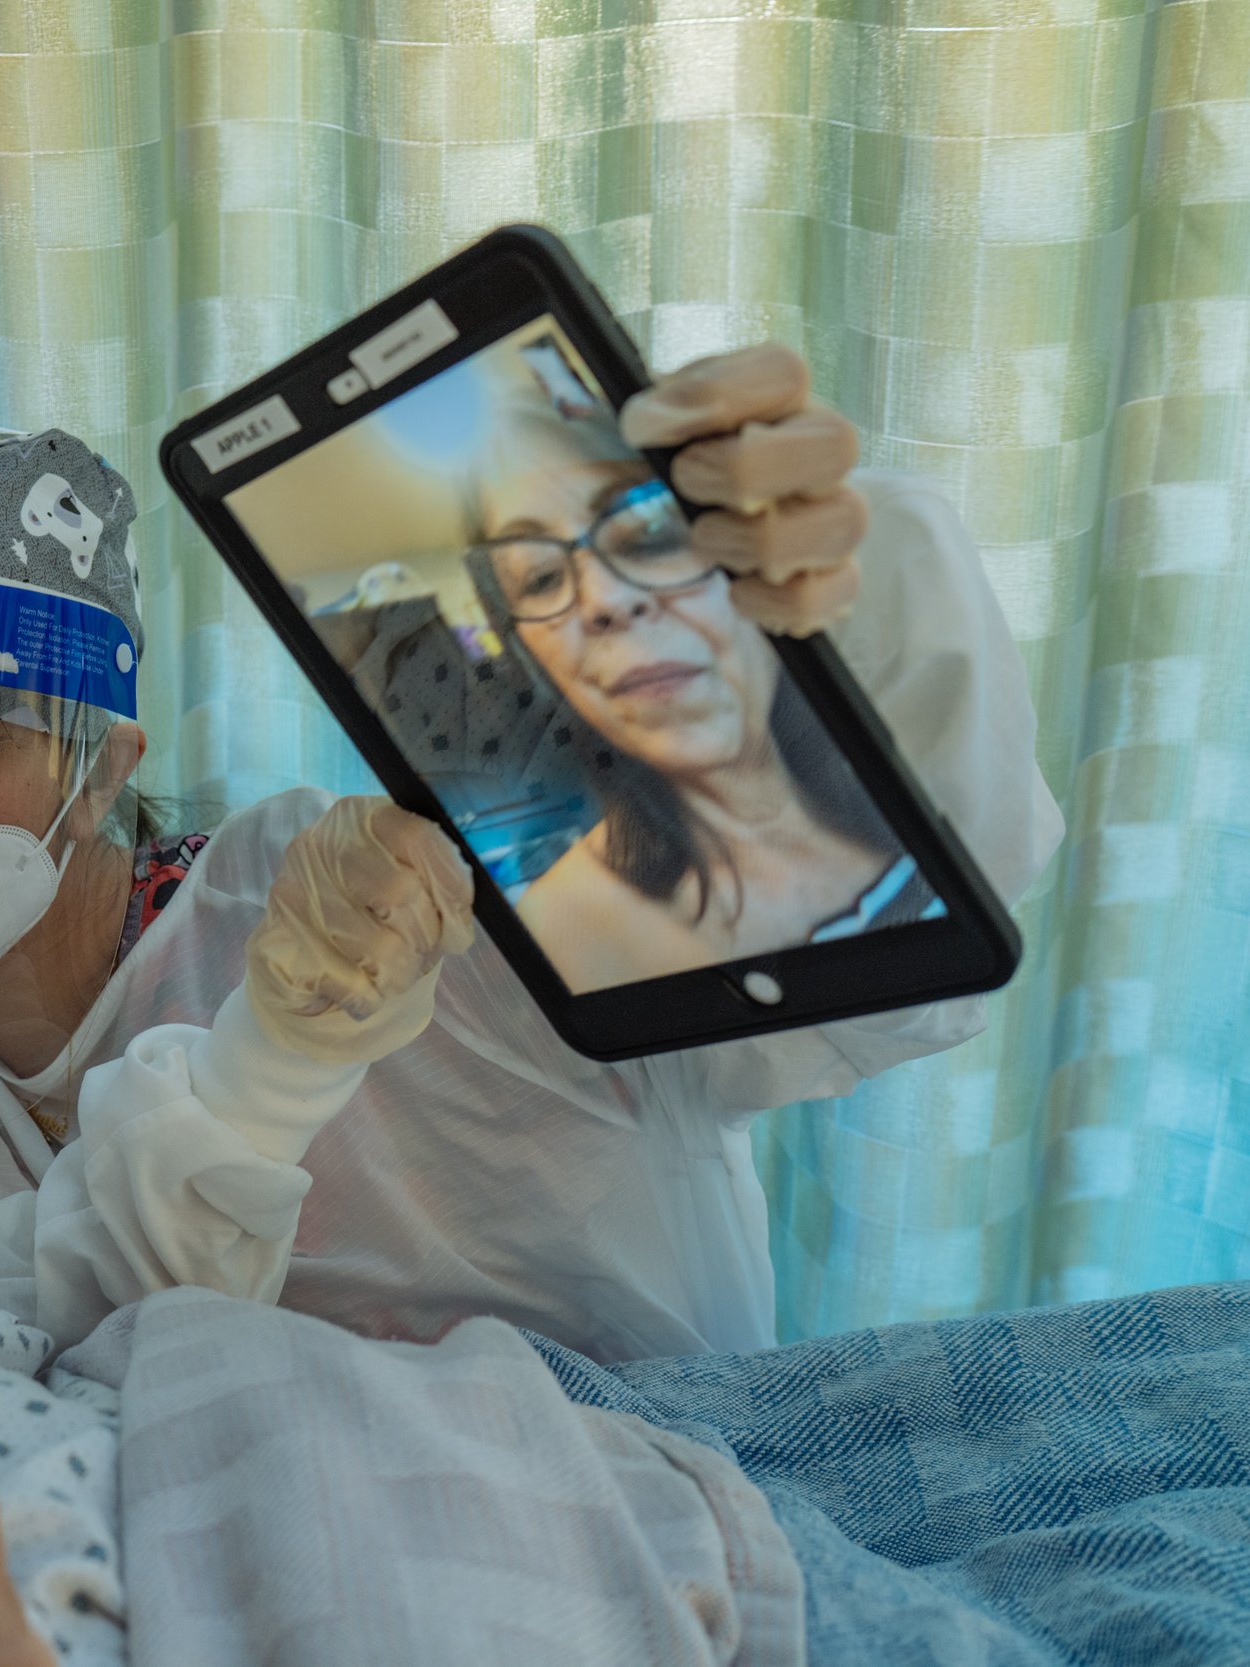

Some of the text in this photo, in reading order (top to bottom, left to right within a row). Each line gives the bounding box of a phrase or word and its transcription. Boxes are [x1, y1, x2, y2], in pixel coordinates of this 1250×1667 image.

[216, 415, 273, 456] APPLE 1
[19, 605, 37, 617] Warm
[18, 616, 33, 628] Only
[33, 619, 48, 630] Used
[17, 636, 29, 647] The
